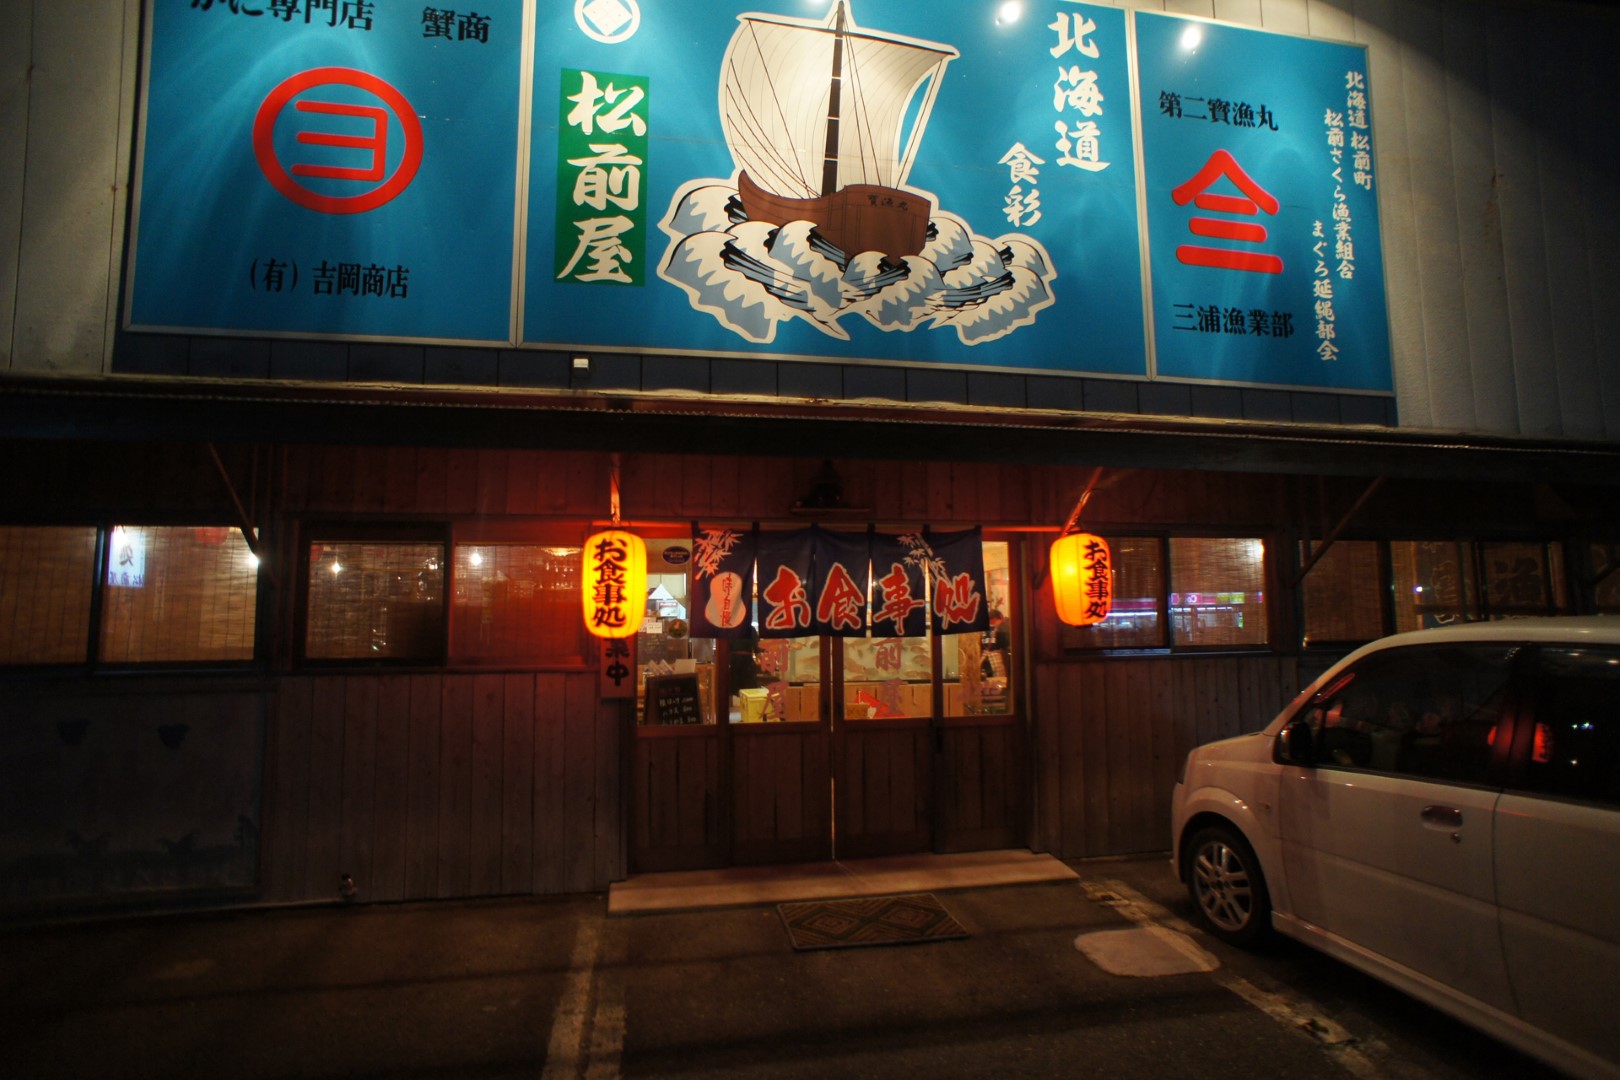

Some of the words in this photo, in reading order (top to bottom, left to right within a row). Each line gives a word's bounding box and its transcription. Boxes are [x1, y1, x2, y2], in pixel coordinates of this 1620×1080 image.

[421, 6, 492, 44] 蟹商
[1047, 11, 1111, 173] 北海道
[556, 70, 647, 284] 松前屋
[997, 141, 1046, 228] 食彩
[1323, 108, 1356, 280] 松前さくら漁業組合
[312, 260, 410, 299] 吉岡商店
[1172, 303, 1295, 339] 三浦漁業部
[591, 538, 629, 629] お食事処
[763, 562, 981, 636] お食事処
[1082, 539, 1110, 620] お食事処
